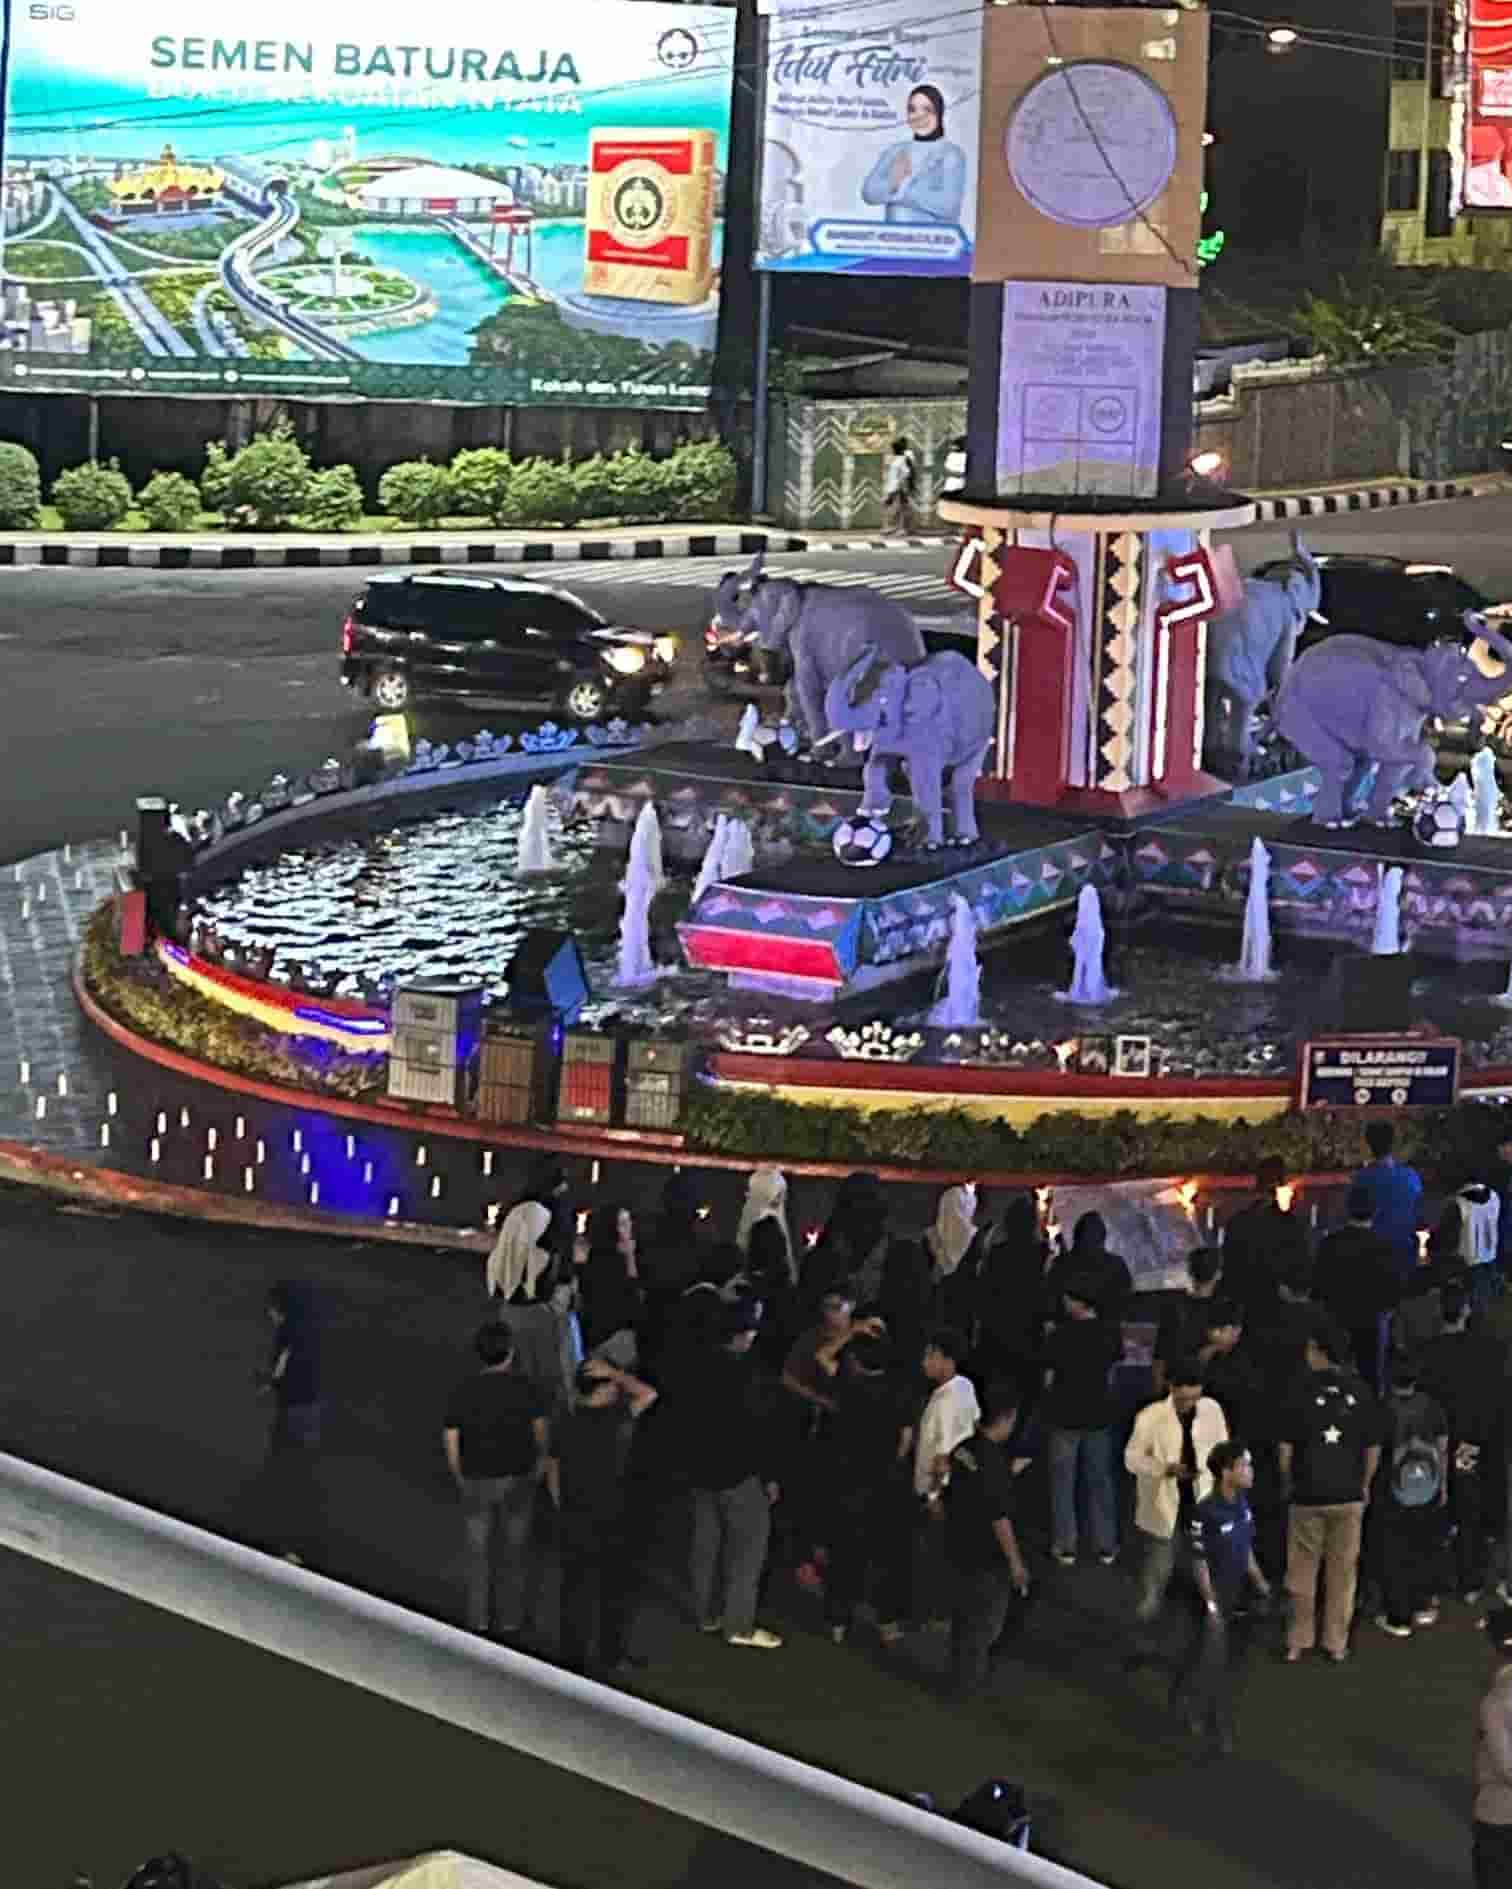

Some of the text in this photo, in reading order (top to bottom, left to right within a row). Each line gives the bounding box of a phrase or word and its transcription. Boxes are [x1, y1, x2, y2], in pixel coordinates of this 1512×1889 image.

[28, 4, 76, 21] SIG
[150, 35, 582, 85] SEMEN BATURAJA
[845, 45, 928, 88] Fitri
